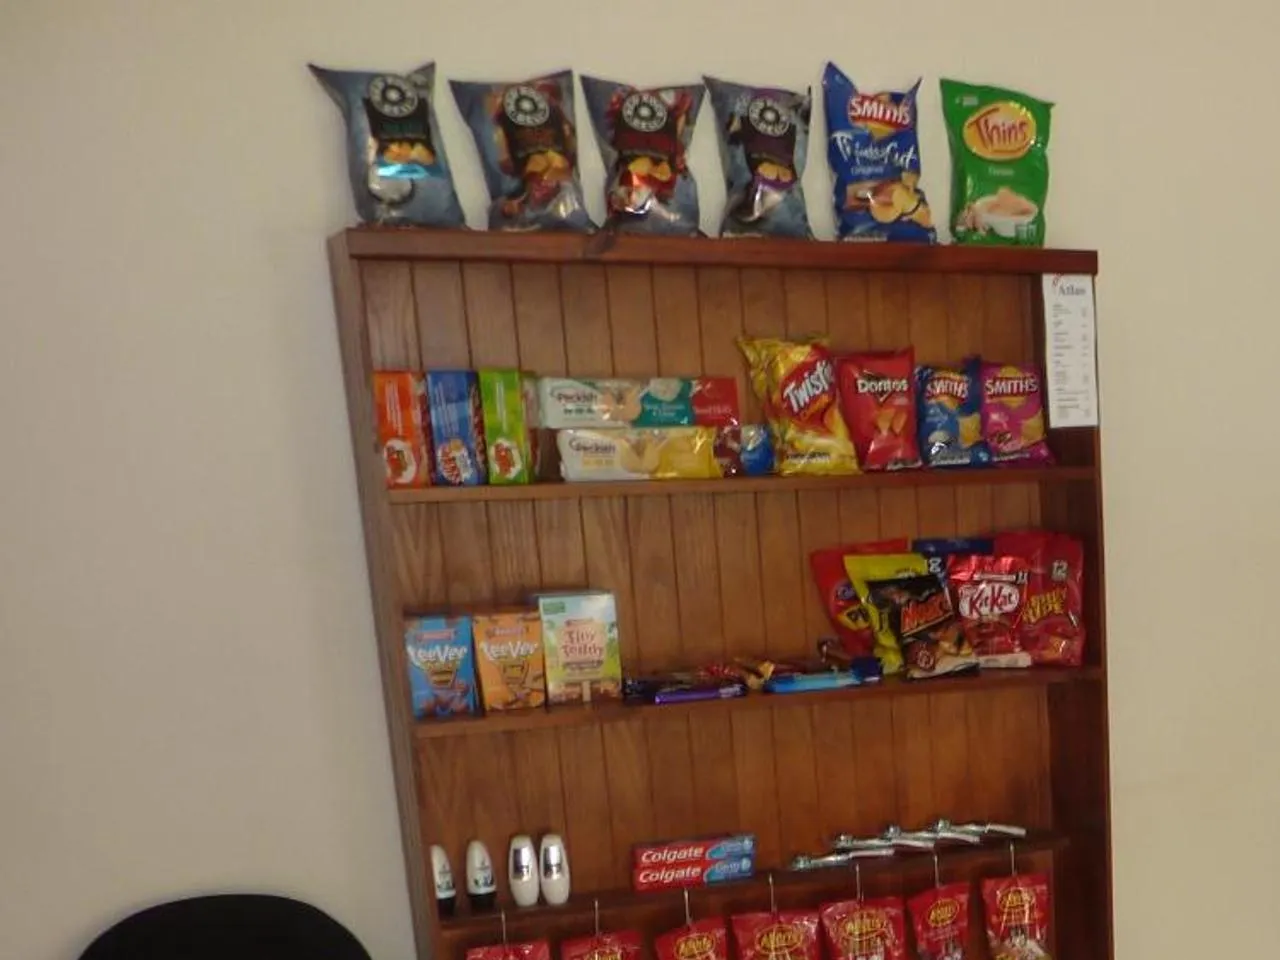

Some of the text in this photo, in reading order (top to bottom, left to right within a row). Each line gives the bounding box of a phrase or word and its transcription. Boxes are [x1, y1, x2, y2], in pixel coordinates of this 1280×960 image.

[967, 106, 1028, 150] Thins
[856, 379, 909, 394] Doritos
[641, 846, 705, 864] Colgate
[639, 866, 702, 884] Colgate
